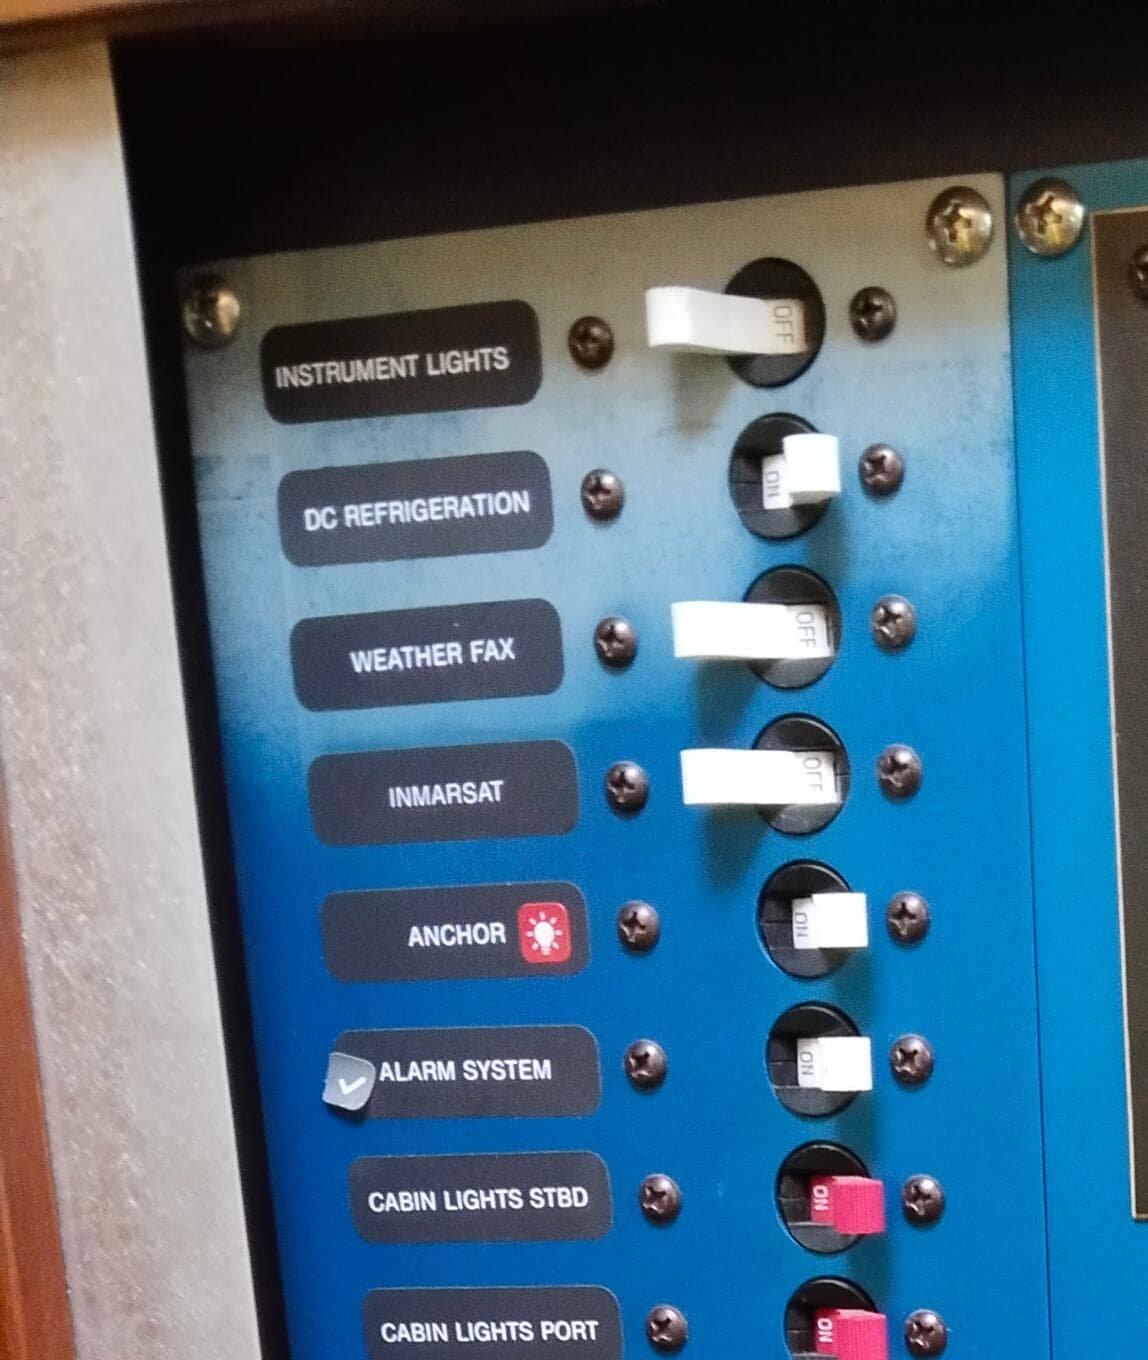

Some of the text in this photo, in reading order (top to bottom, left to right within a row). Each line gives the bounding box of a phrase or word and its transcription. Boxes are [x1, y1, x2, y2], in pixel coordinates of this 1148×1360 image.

[772, 305, 794, 344] OFF
[275, 347, 510, 388] INSTRUMENT LIGHTS
[303, 490, 530, 532] DC REFRIGERATION
[796, 610, 817, 648] OFF
[350, 637, 515, 673] WEATHER FAX
[803, 757, 824, 792] OFF
[388, 780, 504, 809] INMARSAT
[408, 921, 507, 947] ANCHOR
[379, 1058, 552, 1083] ALARM SYSTEM
[368, 1186, 589, 1213] CABIN LIGHTS STBD
[813, 1184, 829, 1211] ON
[380, 1320, 600, 1343] CABIN LIGHTS PORT
[817, 1317, 833, 1343] ON
